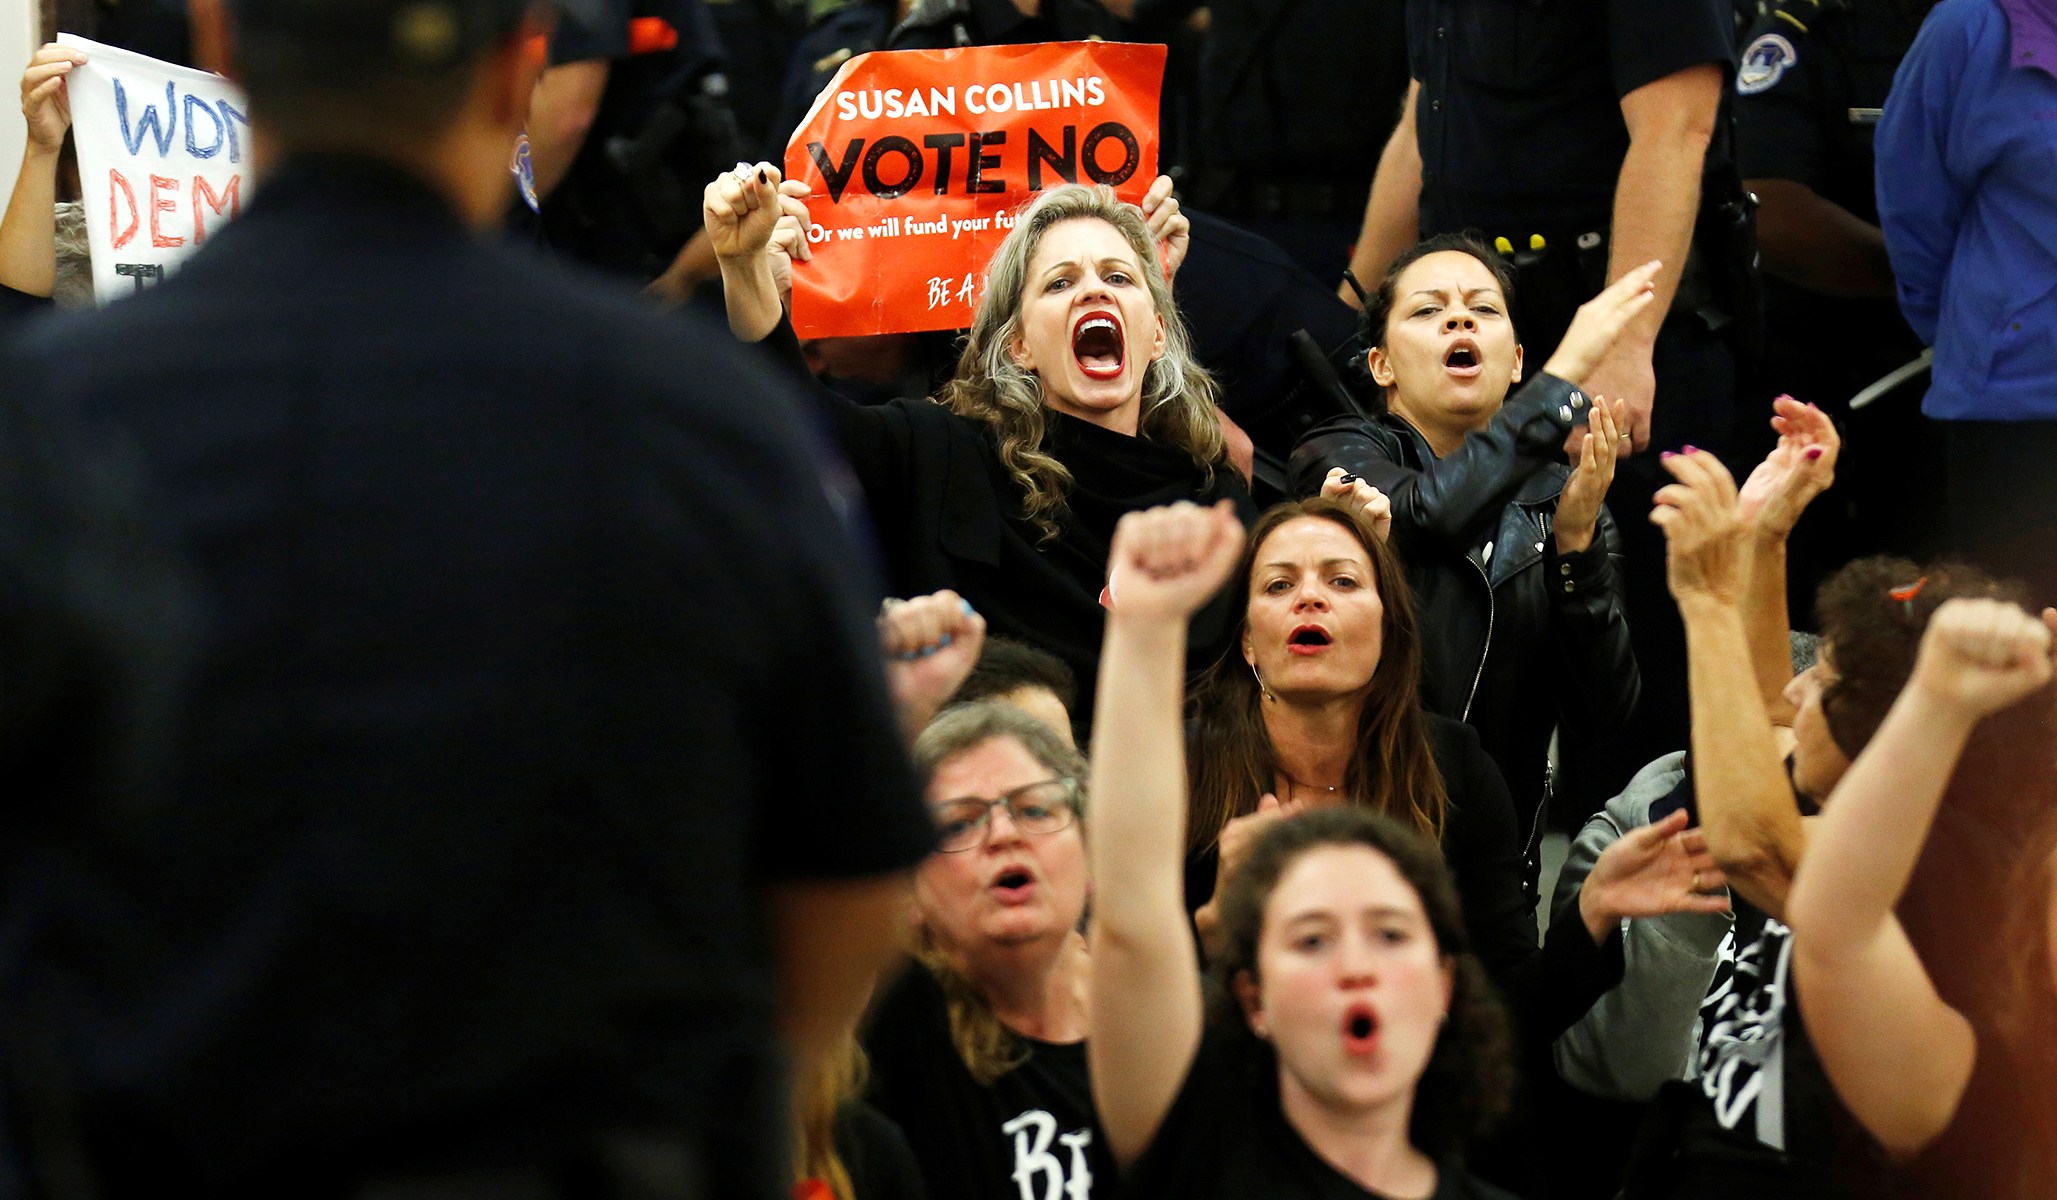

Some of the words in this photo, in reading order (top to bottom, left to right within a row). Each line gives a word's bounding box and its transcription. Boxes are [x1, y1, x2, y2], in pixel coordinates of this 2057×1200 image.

[837, 87, 956, 120] SUSAN
[964, 76, 1105, 114] COLLINS
[806, 130, 1006, 204] VOTE
[1028, 121, 1141, 192] NO
[807, 224, 832, 244] Or
[837, 226, 864, 241] we
[867, 217, 900, 238] will
[904, 213, 948, 236] fund
[952, 216, 990, 240] your
[115, 263, 166, 293] T
[926, 277, 953, 310] BE
[956, 273, 975, 307] A
